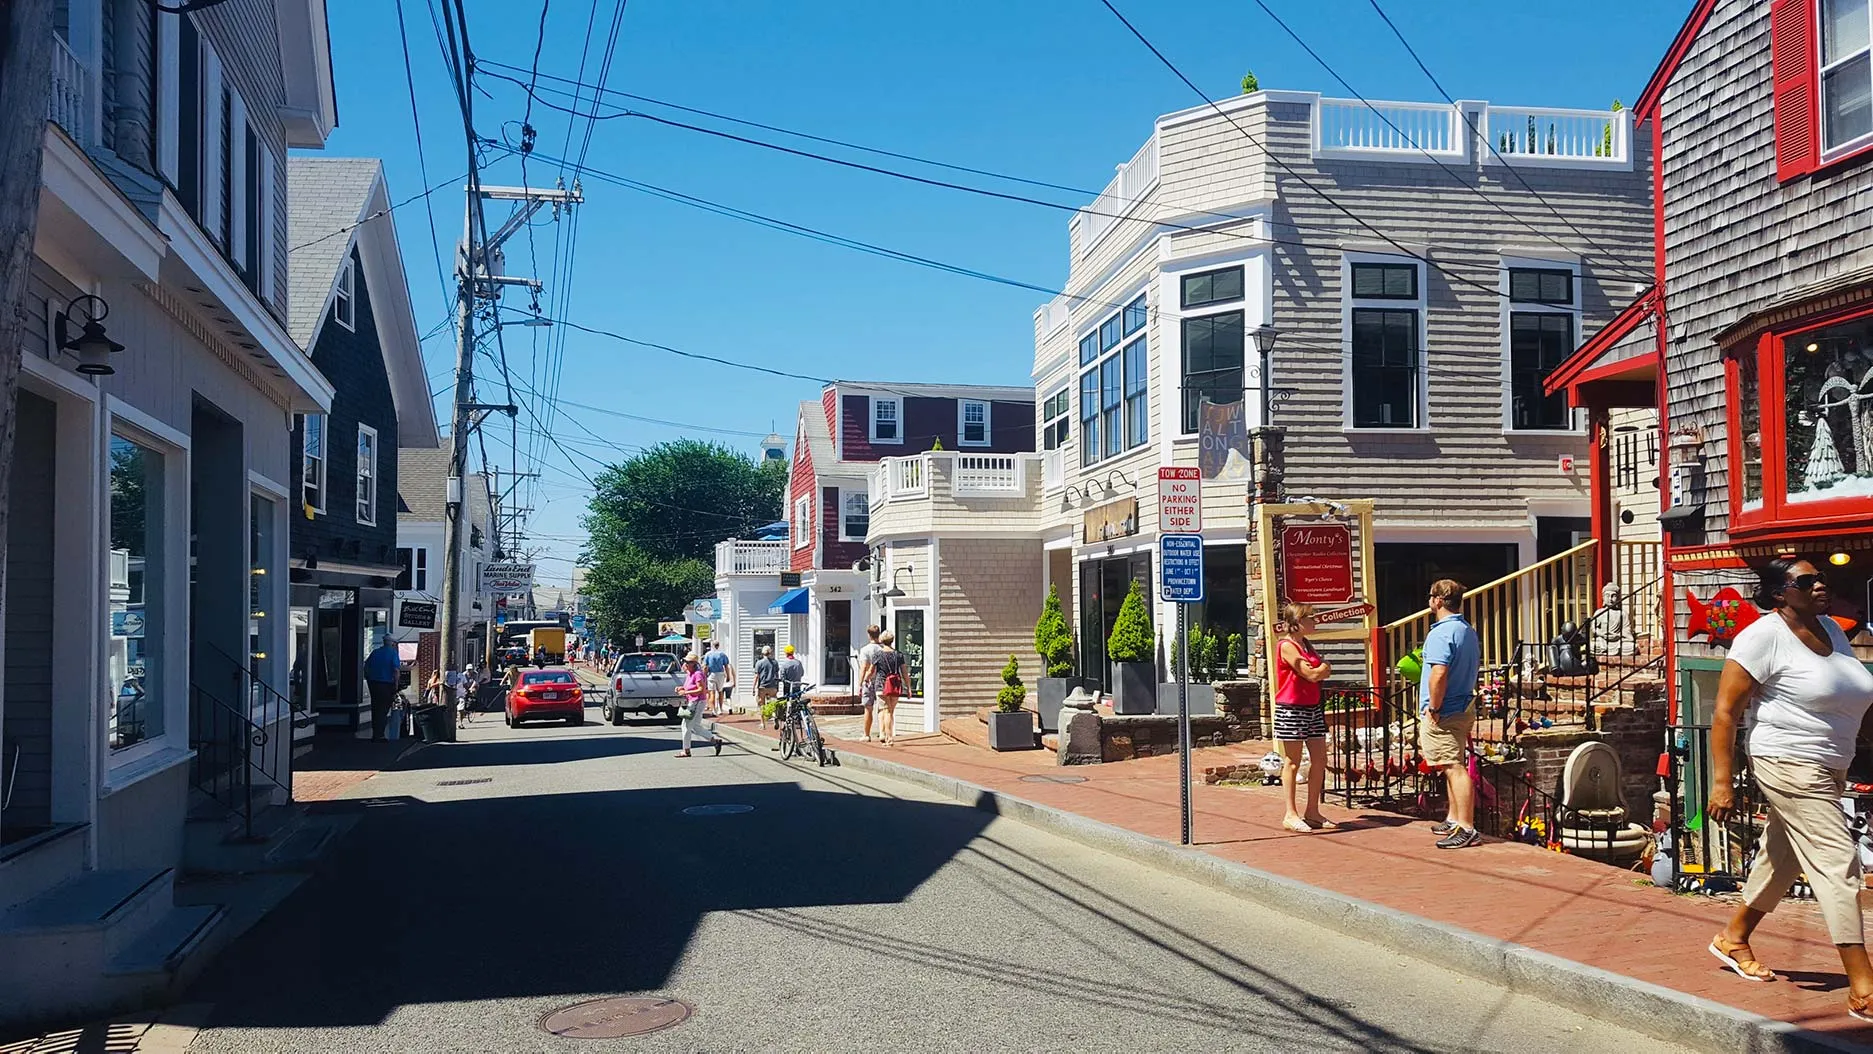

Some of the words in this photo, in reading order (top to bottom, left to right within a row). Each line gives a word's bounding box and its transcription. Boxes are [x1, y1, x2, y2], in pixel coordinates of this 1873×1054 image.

[1160, 469, 1176, 478] TOW
[1178, 469, 1198, 478] ZONE
[1172, 484, 1186, 492] NO
[1162, 495, 1198, 504] PARKING
[1164, 506, 1194, 515] EITHER
[1170, 518, 1190, 526] SIDE
[1290, 530, 1343, 547] Monty's
[514, 564, 532, 572] End
[1322, 607, 1365, 622] Collection
[403, 619, 431, 628] GALLERY
